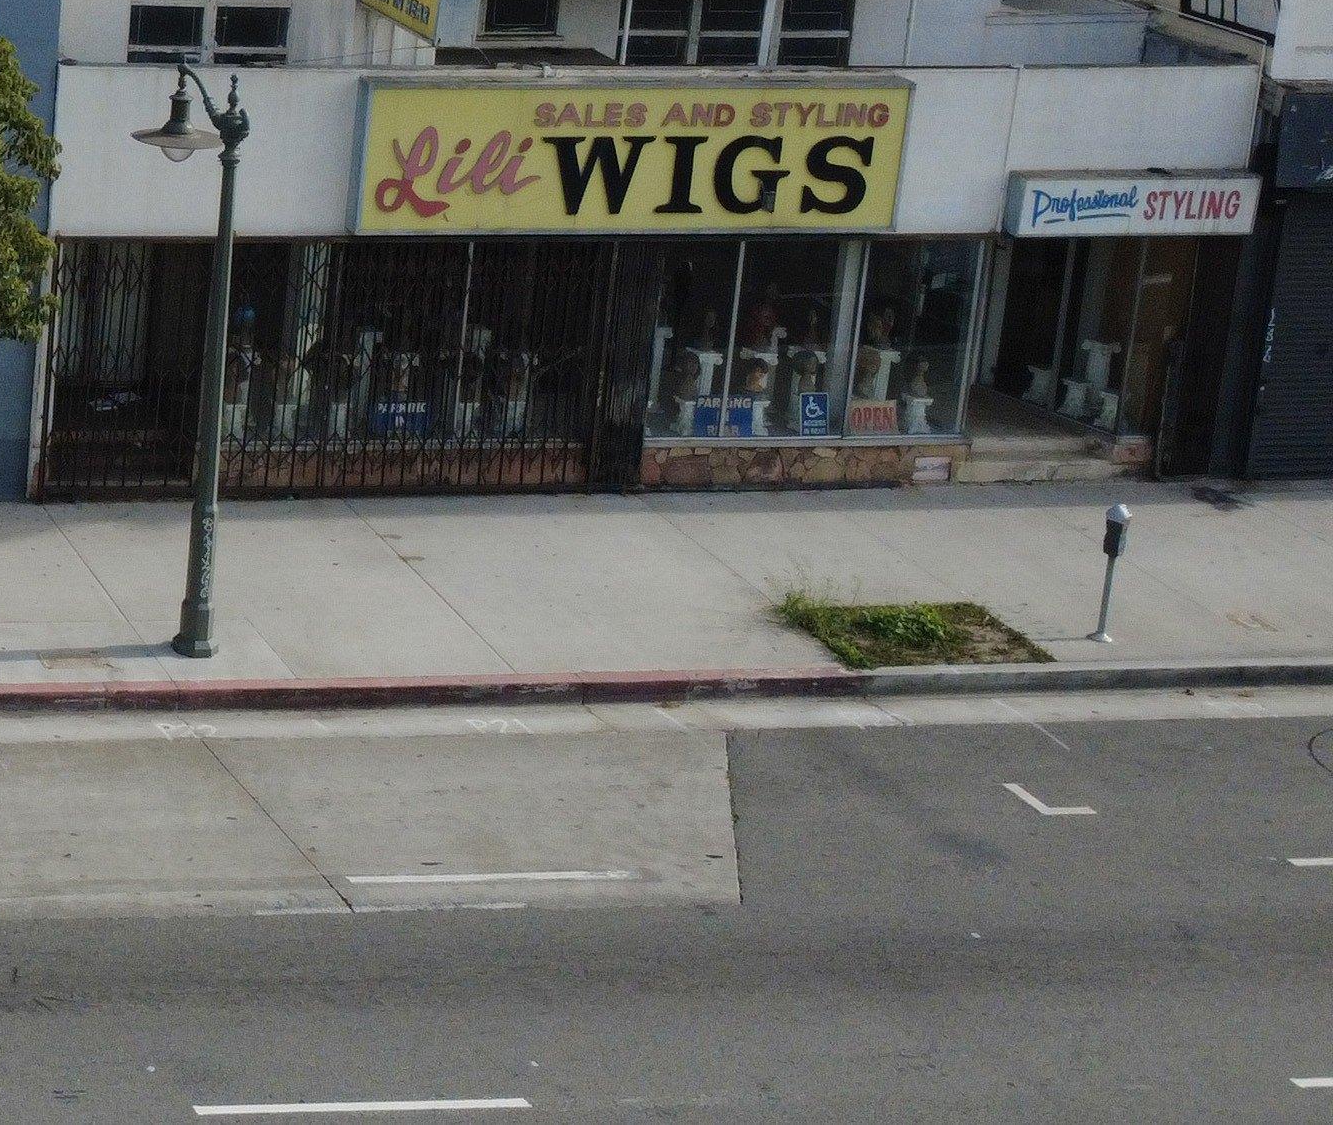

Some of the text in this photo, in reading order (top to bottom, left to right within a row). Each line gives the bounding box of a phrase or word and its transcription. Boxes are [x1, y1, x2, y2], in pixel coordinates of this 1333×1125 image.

[534, 102, 891, 127] SALES AND STYLING
[374, 125, 875, 219] Lili WIGS
[1030, 185, 1242, 229] Professional STYLING
[851, 406, 895, 431] OPEN
